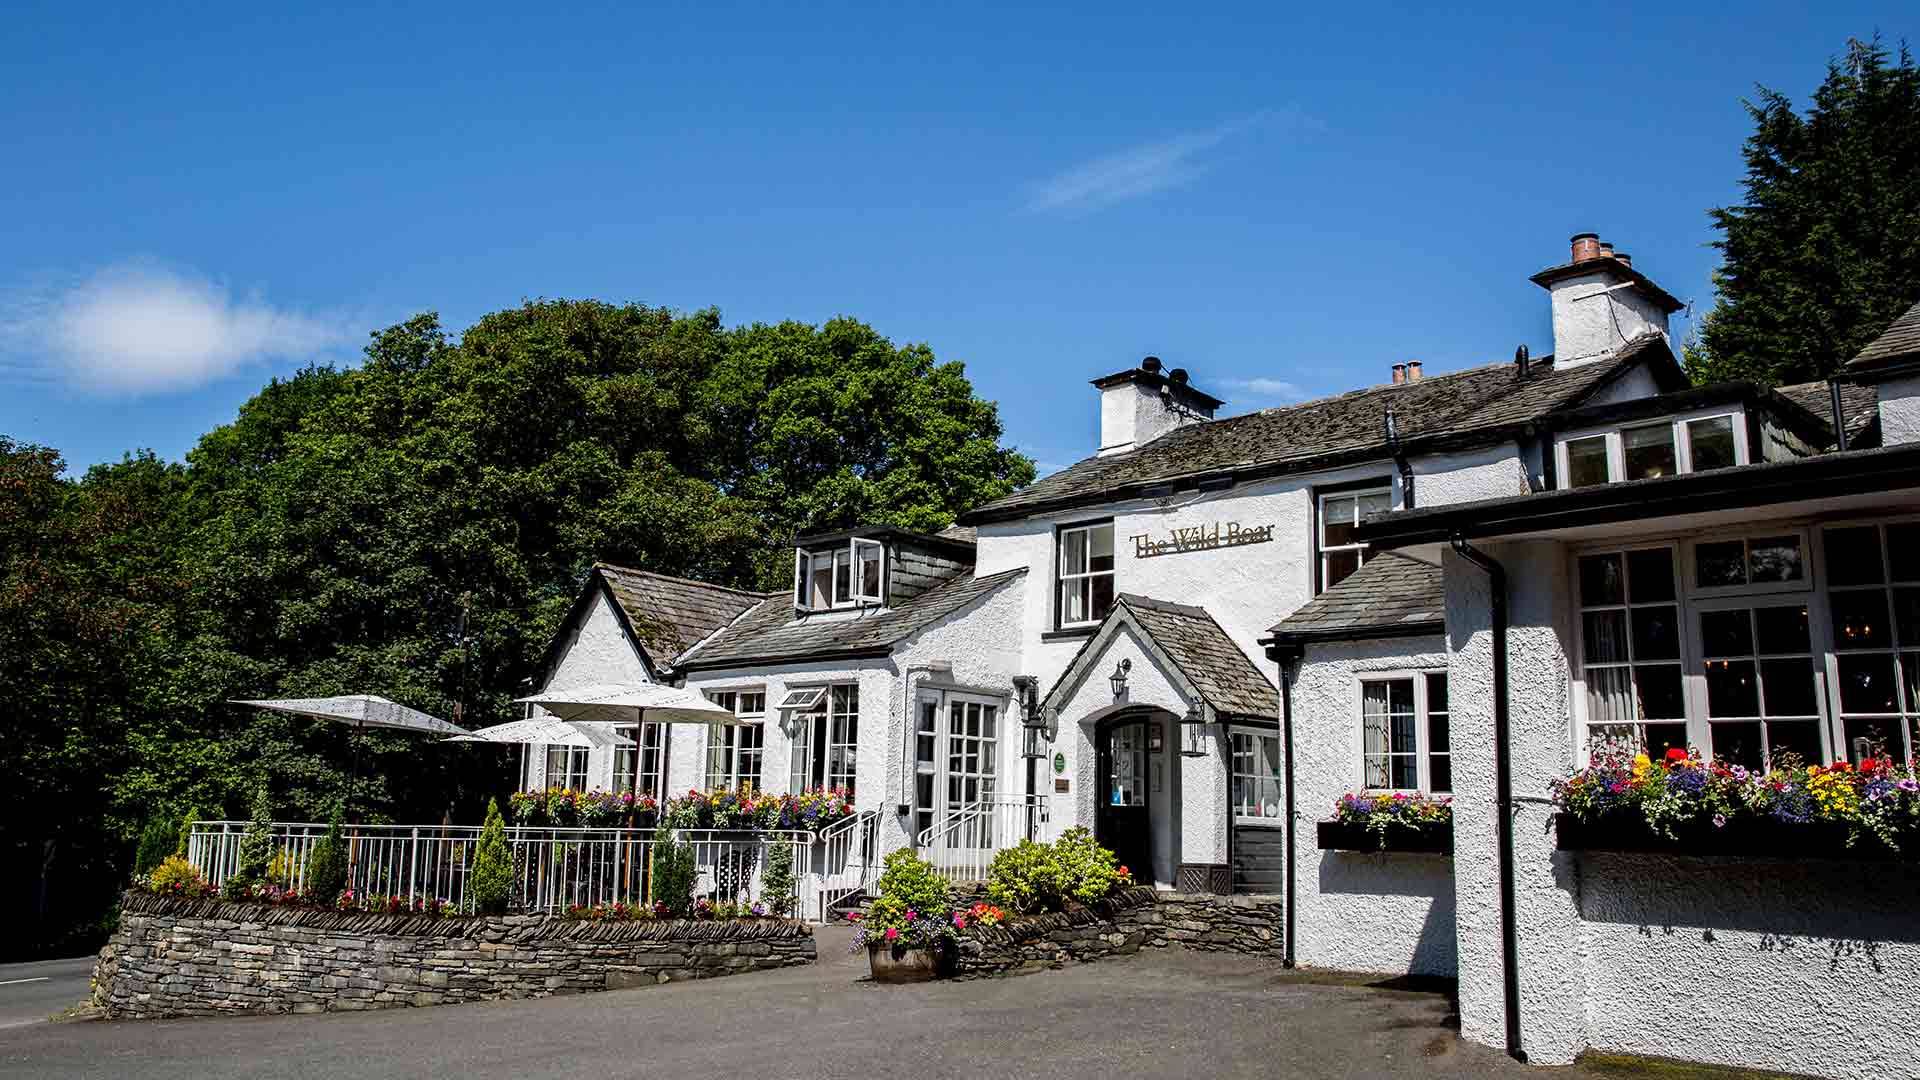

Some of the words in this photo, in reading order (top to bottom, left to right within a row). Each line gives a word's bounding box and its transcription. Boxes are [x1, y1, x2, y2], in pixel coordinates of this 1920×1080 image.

[1129, 533, 1167, 558] The
[1171, 521, 1219, 553] Wild
[1227, 522, 1275, 546] Boar
